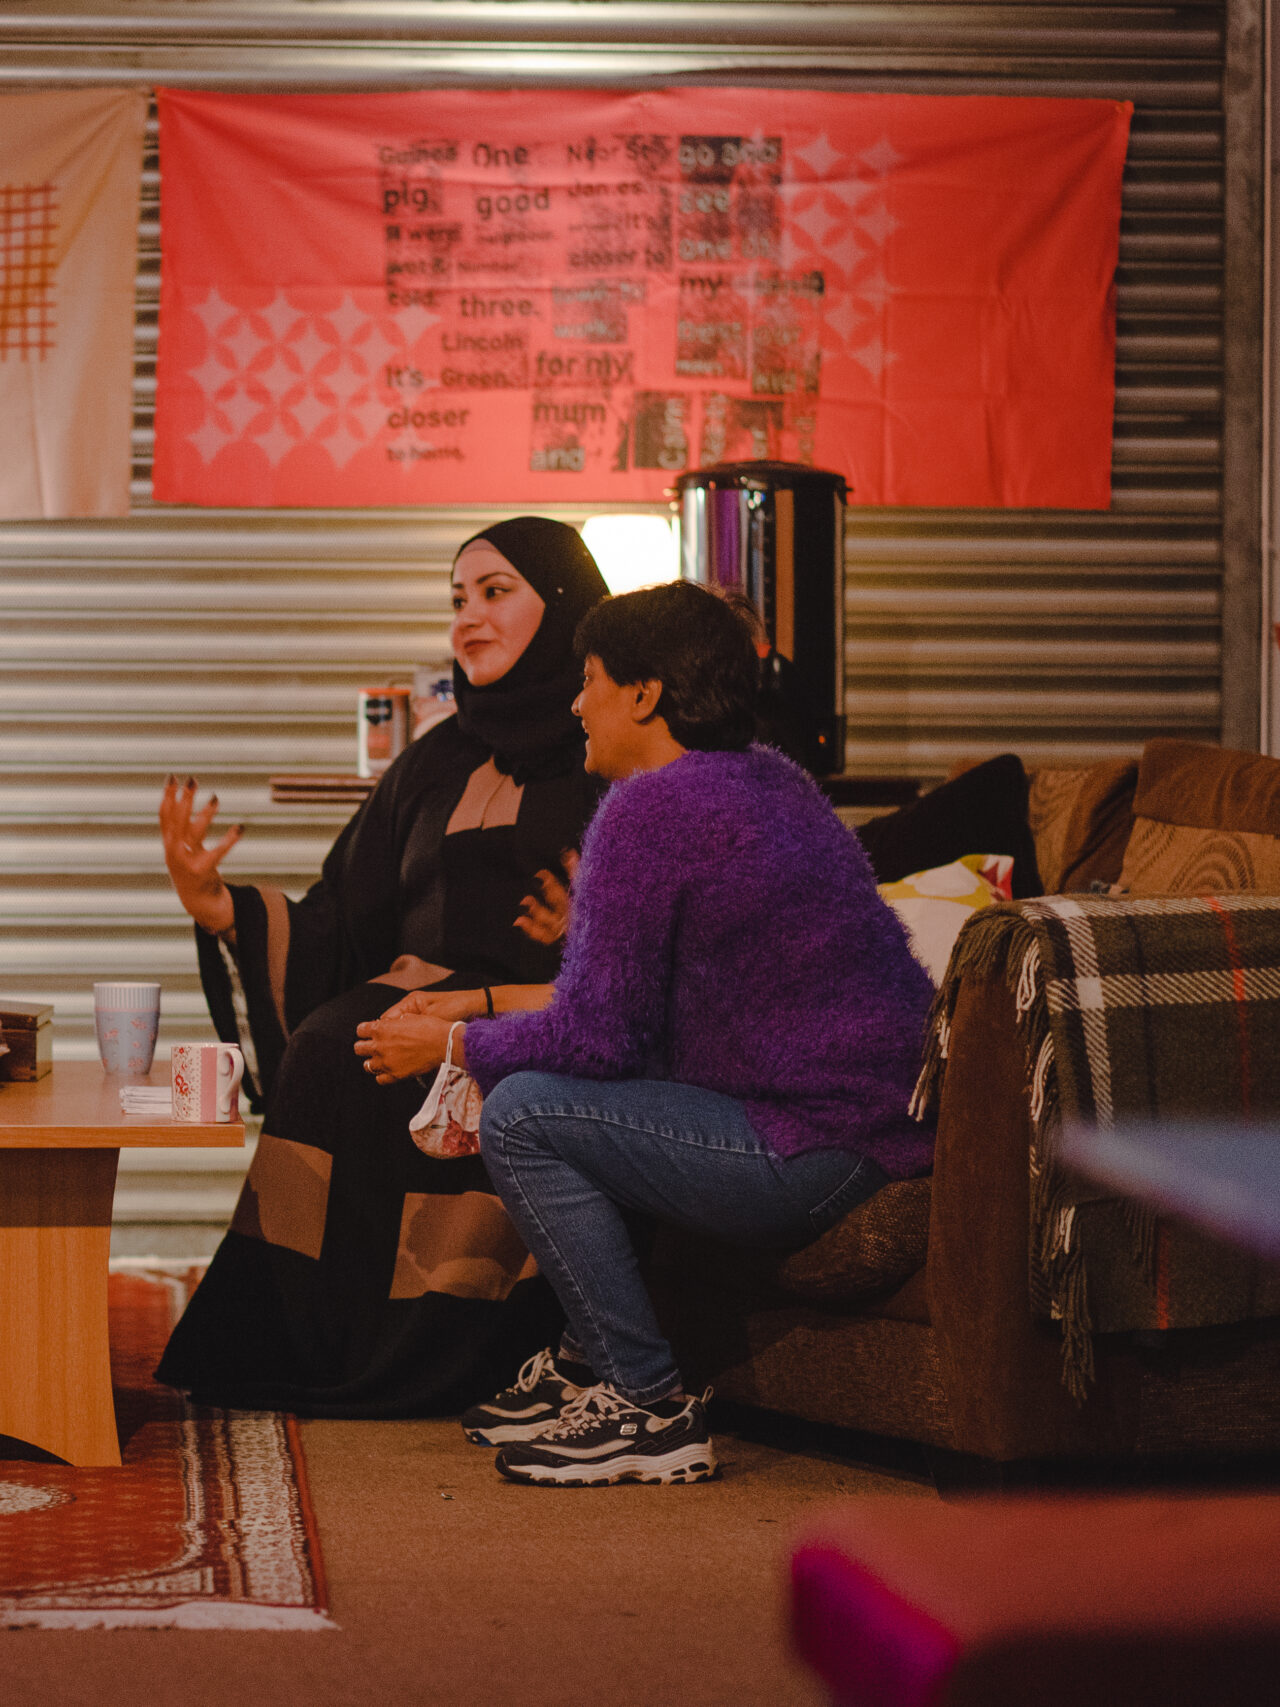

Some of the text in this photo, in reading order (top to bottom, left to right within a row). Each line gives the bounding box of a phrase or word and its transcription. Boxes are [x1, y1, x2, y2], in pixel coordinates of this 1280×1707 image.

[473, 143, 529, 167] One
[477, 187, 550, 220] good
[441, 331, 524, 352] Lincoln
[537, 351, 578, 376] for
[387, 406, 471, 429] closer
[533, 403, 606, 422] mum
